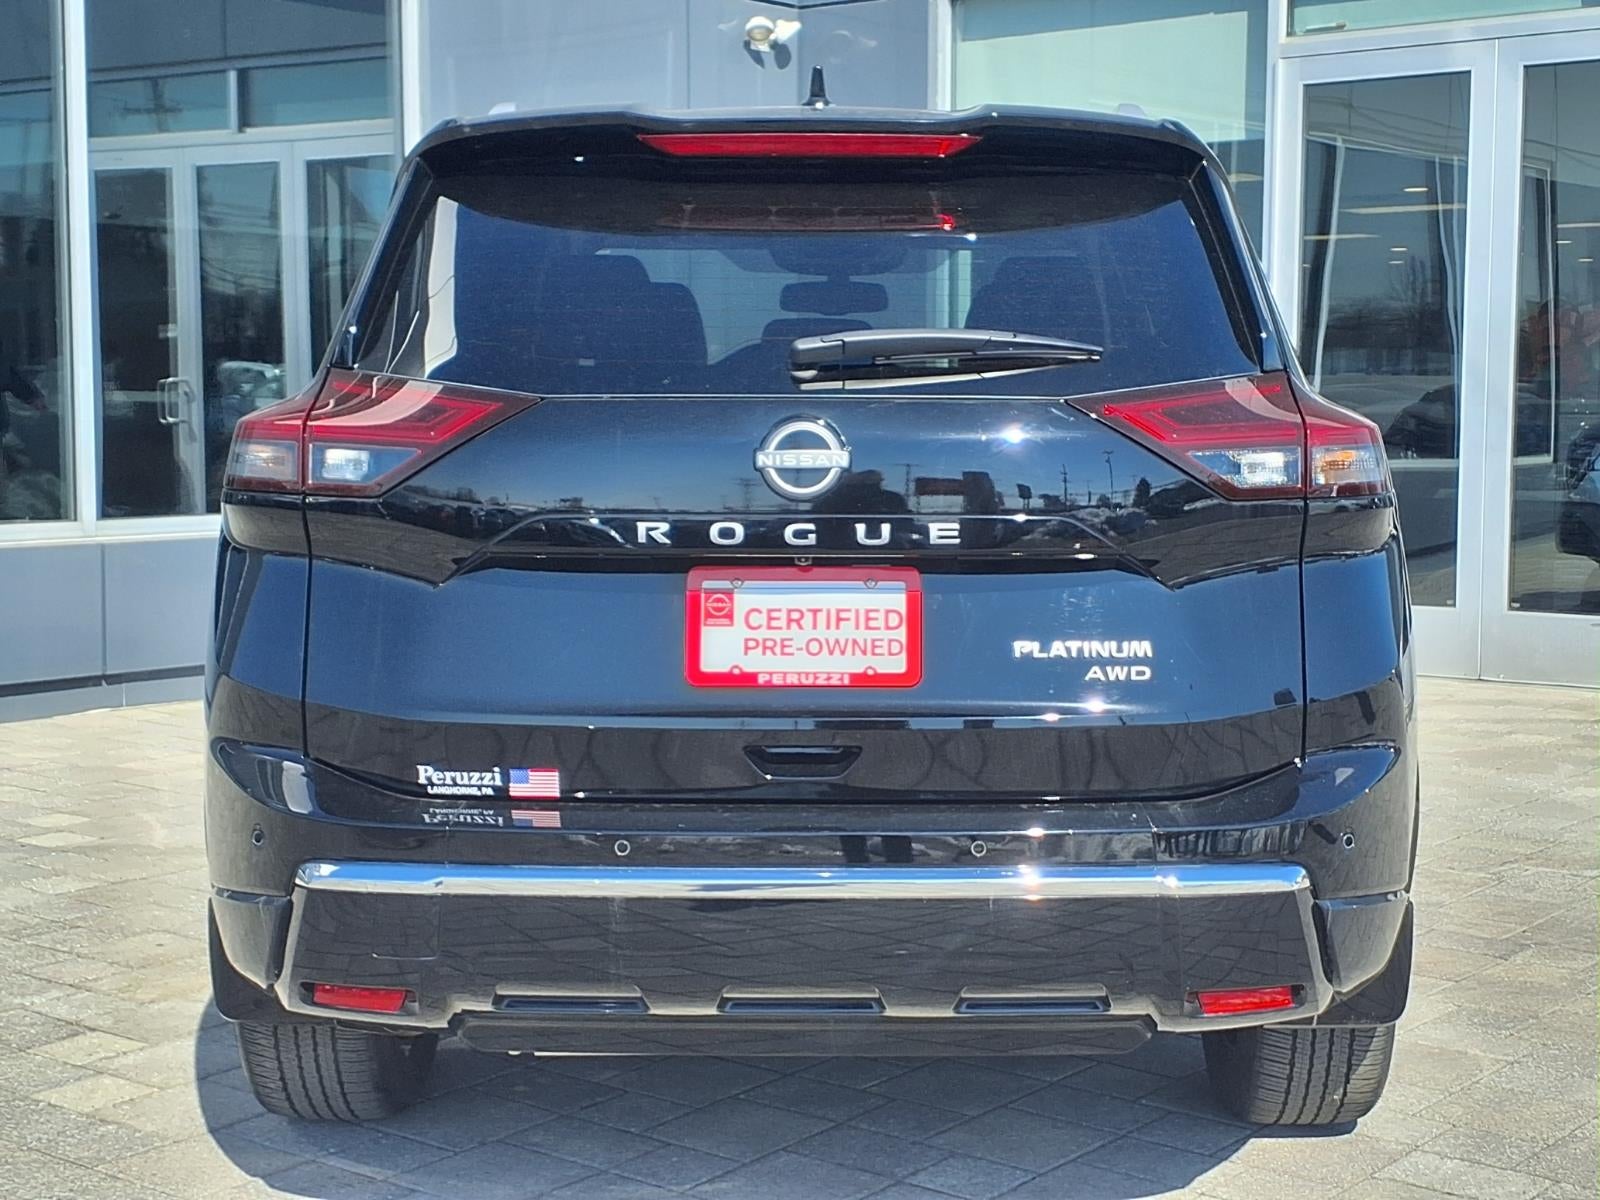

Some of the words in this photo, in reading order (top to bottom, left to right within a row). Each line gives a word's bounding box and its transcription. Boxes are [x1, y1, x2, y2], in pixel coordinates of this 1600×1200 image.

[757, 452, 849, 467] NISSAN
[636, 521, 962, 546] ROGUE
[743, 608, 905, 632] CERTIFIED
[742, 637, 905, 657] PRE-OWNED
[1012, 640, 1153, 659] PLATINUM
[757, 673, 850, 686] PERUZZI
[1084, 665, 1152, 681] AWD
[416, 764, 503, 786] Peruzzi
